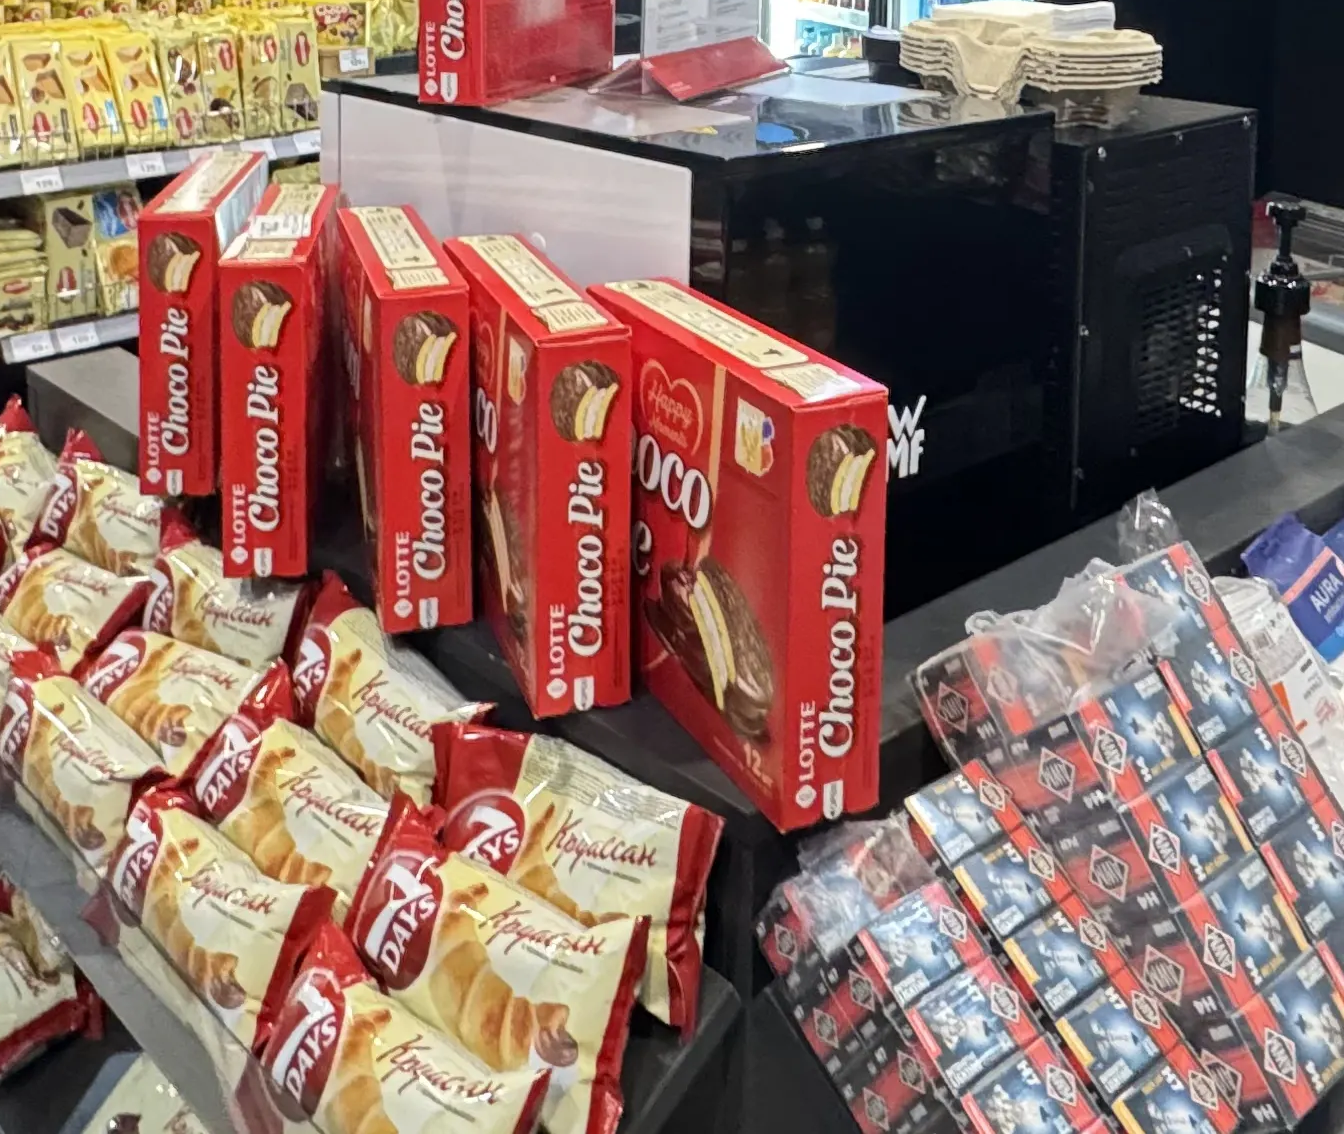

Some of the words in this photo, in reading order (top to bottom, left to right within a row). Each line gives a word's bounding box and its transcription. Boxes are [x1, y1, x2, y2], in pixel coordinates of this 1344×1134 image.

[425, 21, 437, 78] LOTTE
[160, 306, 189, 361] Pie
[161, 363, 190, 456] Choco
[246, 364, 280, 424] Pie
[147, 411, 160, 466] LOTTE
[411, 401, 445, 466] Pie
[232, 483, 246, 545] LOTTE
[248, 427, 280, 533] Choco
[568, 460, 606, 529] Pie
[631, 432, 713, 530] oco
[412, 468, 446, 581] Choco
[396, 530, 411, 597] LOTTE
[567, 534, 605, 658] Choco
[821, 537, 859, 614] Pie
[1309, 572, 1344, 614] AURA
[549, 603, 565, 677] LOTTE
[818, 619, 858, 759] Choco
[798, 700, 817, 784] LOTTE
[201, 753, 253, 812] DAYS
[279, 764, 381, 838] Круассан
[547, 807, 658, 873] Круассан
[379, 893, 440, 977] DAYS
[283, 1015, 338, 1102] DAYS
